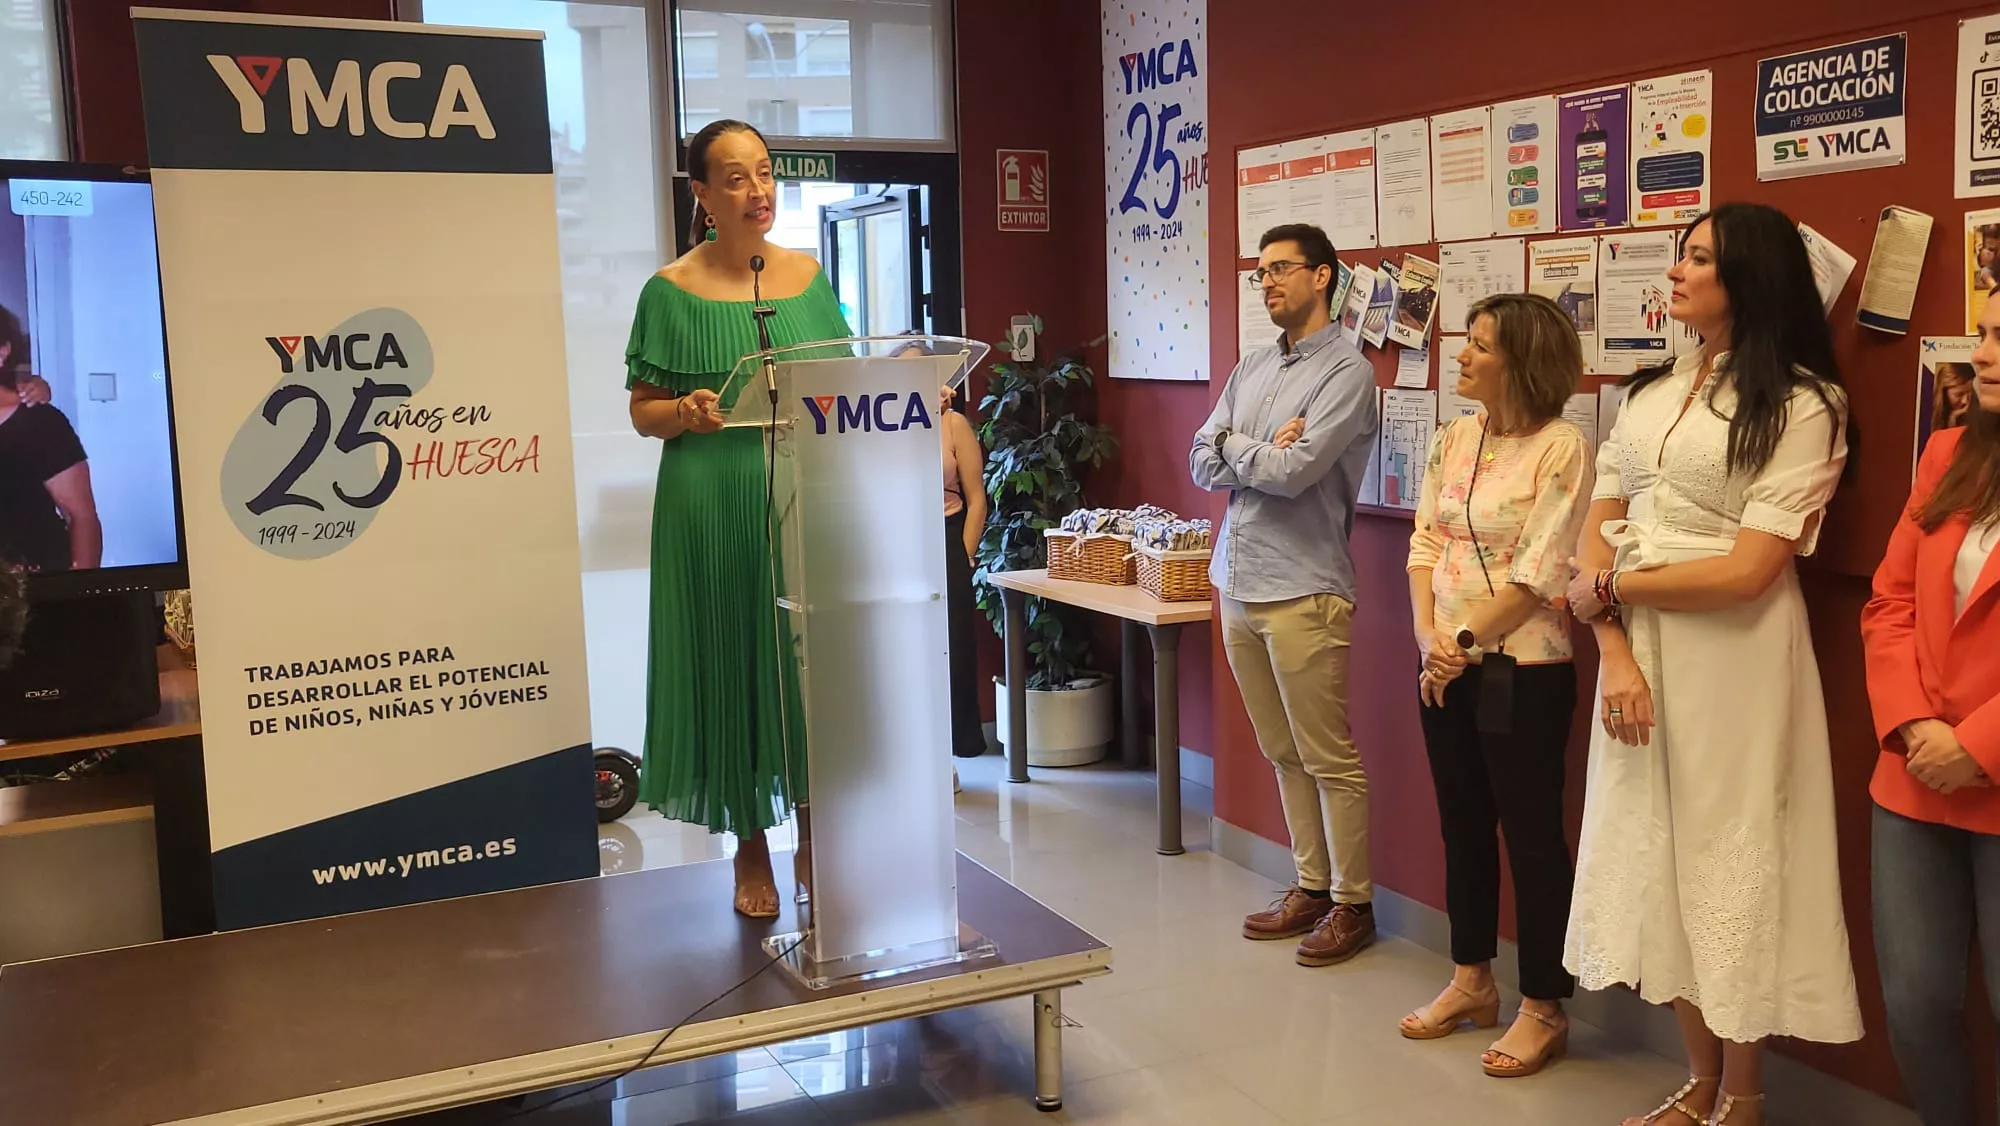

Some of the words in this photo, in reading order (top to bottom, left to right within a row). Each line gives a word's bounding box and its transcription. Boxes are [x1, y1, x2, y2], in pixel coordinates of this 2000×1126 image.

[1119, 38, 1197, 95] YMCA
[1770, 53, 1856, 89] AGENCIA
[1862, 46, 1890, 71] DE
[206, 54, 497, 140] YMCA
[1764, 72, 1894, 114] COLOCACIÓN
[1177, 121, 1203, 143] años
[1803, 106, 1864, 126] 9900000145
[1119, 102, 1181, 219] 25
[1817, 126, 1891, 158] YMCA
[773, 157, 829, 177] ALIDA
[20, 190, 84, 206] 450-242
[1002, 211, 1046, 225] EXTINTOR
[1132, 223, 1150, 243] 1999
[1160, 220, 1182, 240] 2024
[265, 333, 408, 373] YMCA
[374, 403, 447, 433] años
[452, 403, 491, 426] en
[802, 391, 932, 435] YMCA
[246, 377, 412, 516] 25
[406, 434, 539, 480] HUESCA
[259, 524, 298, 545] 1999
[313, 520, 355, 541] 2024
[244, 652, 391, 683] TRABAJAMOS
[399, 646, 455, 666] PARA
[247, 679, 401, 710] DESARROLLAR
[410, 674, 432, 690] EL
[438, 660, 550, 686] POTENCIAL
[250, 720, 277, 736] DE
[285, 708, 362, 732] NIÑOS,
[368, 698, 434, 721] NIÑAS
[441, 697, 453, 712] Y
[459, 685, 548, 710] JÓVENES
[312, 837, 516, 885] www.ymca.es
